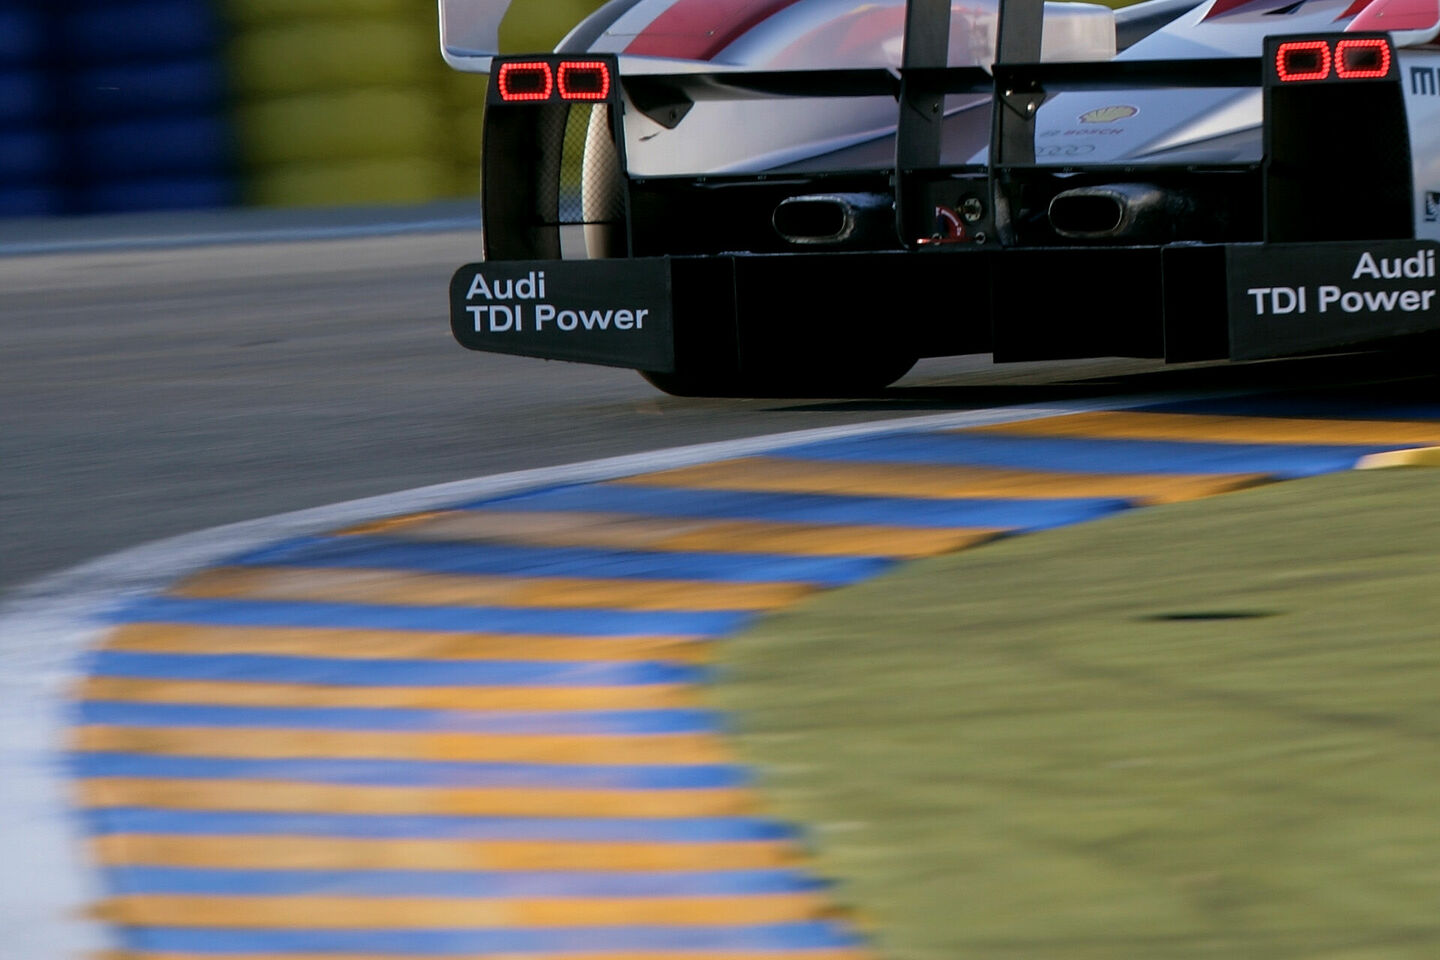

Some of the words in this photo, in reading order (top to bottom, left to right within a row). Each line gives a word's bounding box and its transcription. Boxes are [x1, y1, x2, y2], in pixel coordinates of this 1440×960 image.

[1352, 249, 1436, 280] Audi
[465, 271, 546, 301] Audi
[1247, 286, 1306, 315] TDI
[1319, 285, 1436, 314] Power
[466, 305, 522, 333] TDI
[535, 304, 649, 332] Power
